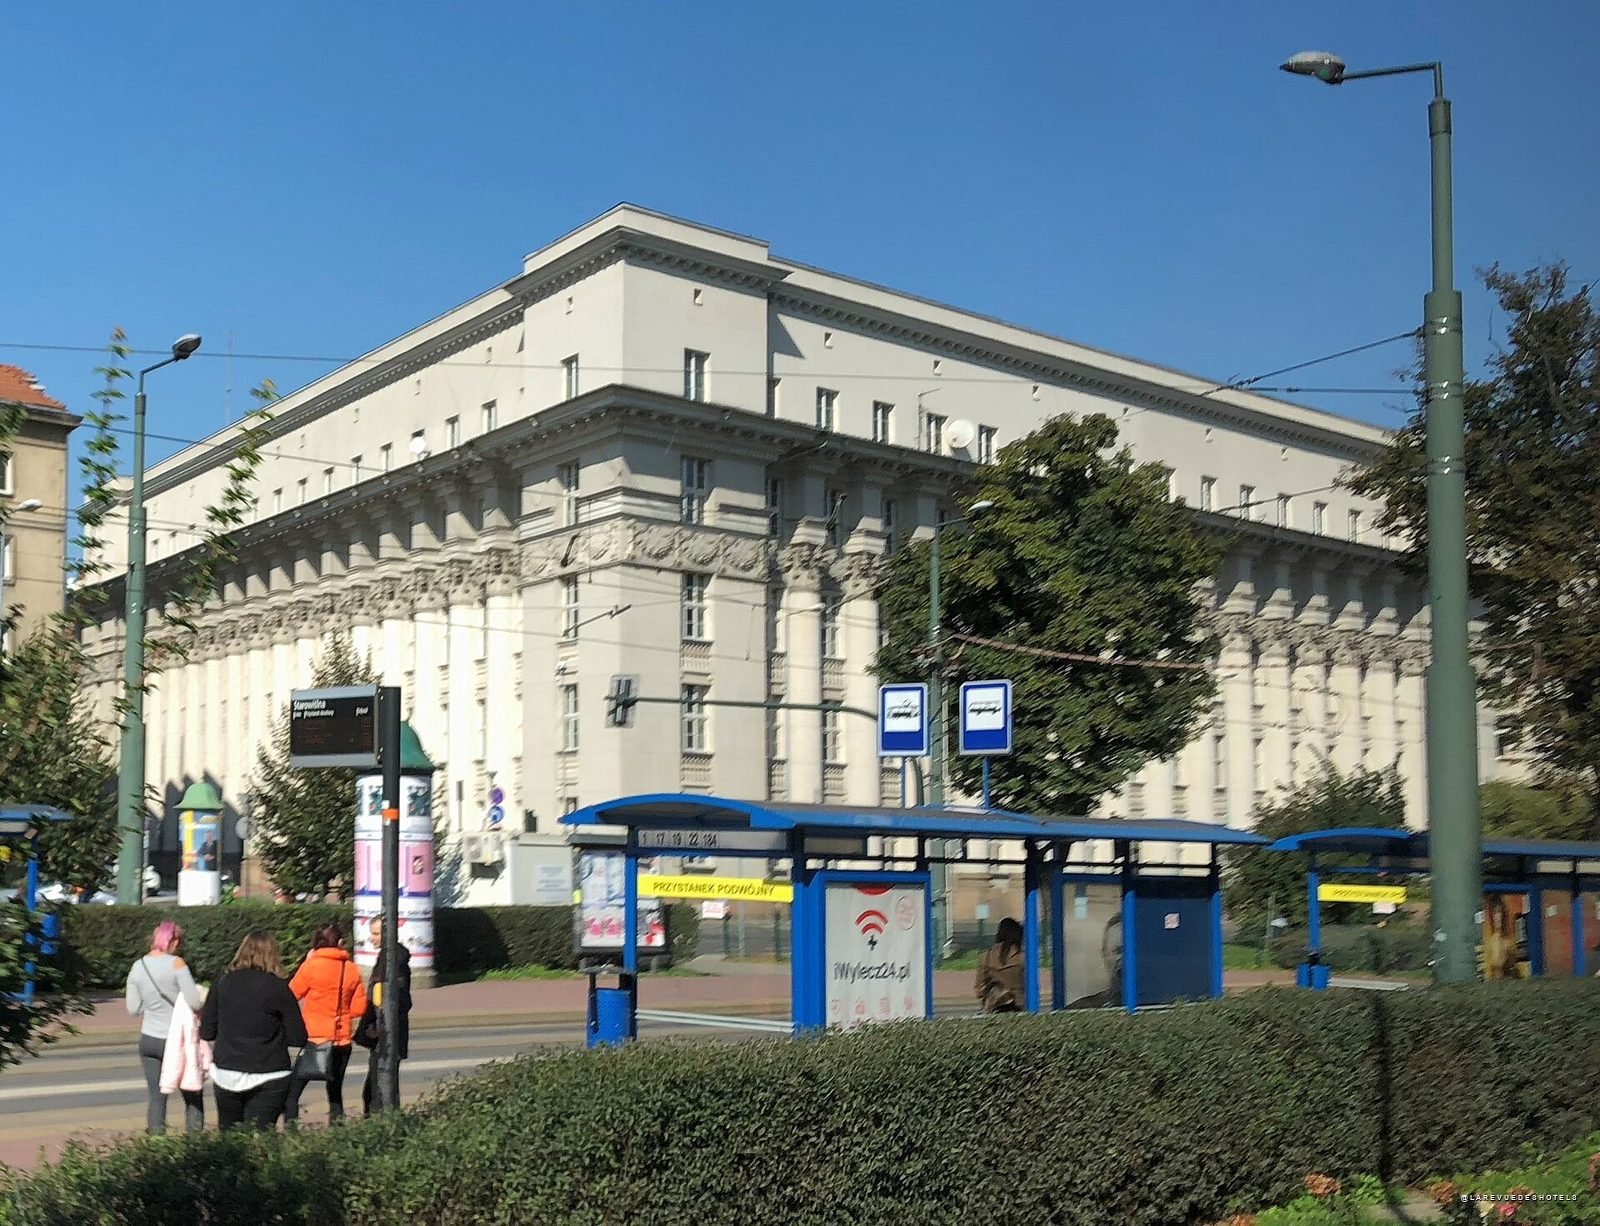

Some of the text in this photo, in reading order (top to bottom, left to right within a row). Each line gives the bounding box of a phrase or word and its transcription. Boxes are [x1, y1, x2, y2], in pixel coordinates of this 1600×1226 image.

[655, 832, 666, 846] 17
[652, 881, 776, 897] PRZYSTANEK PODWÓJNY
[833, 961, 912, 985] iWylecz24.pl
